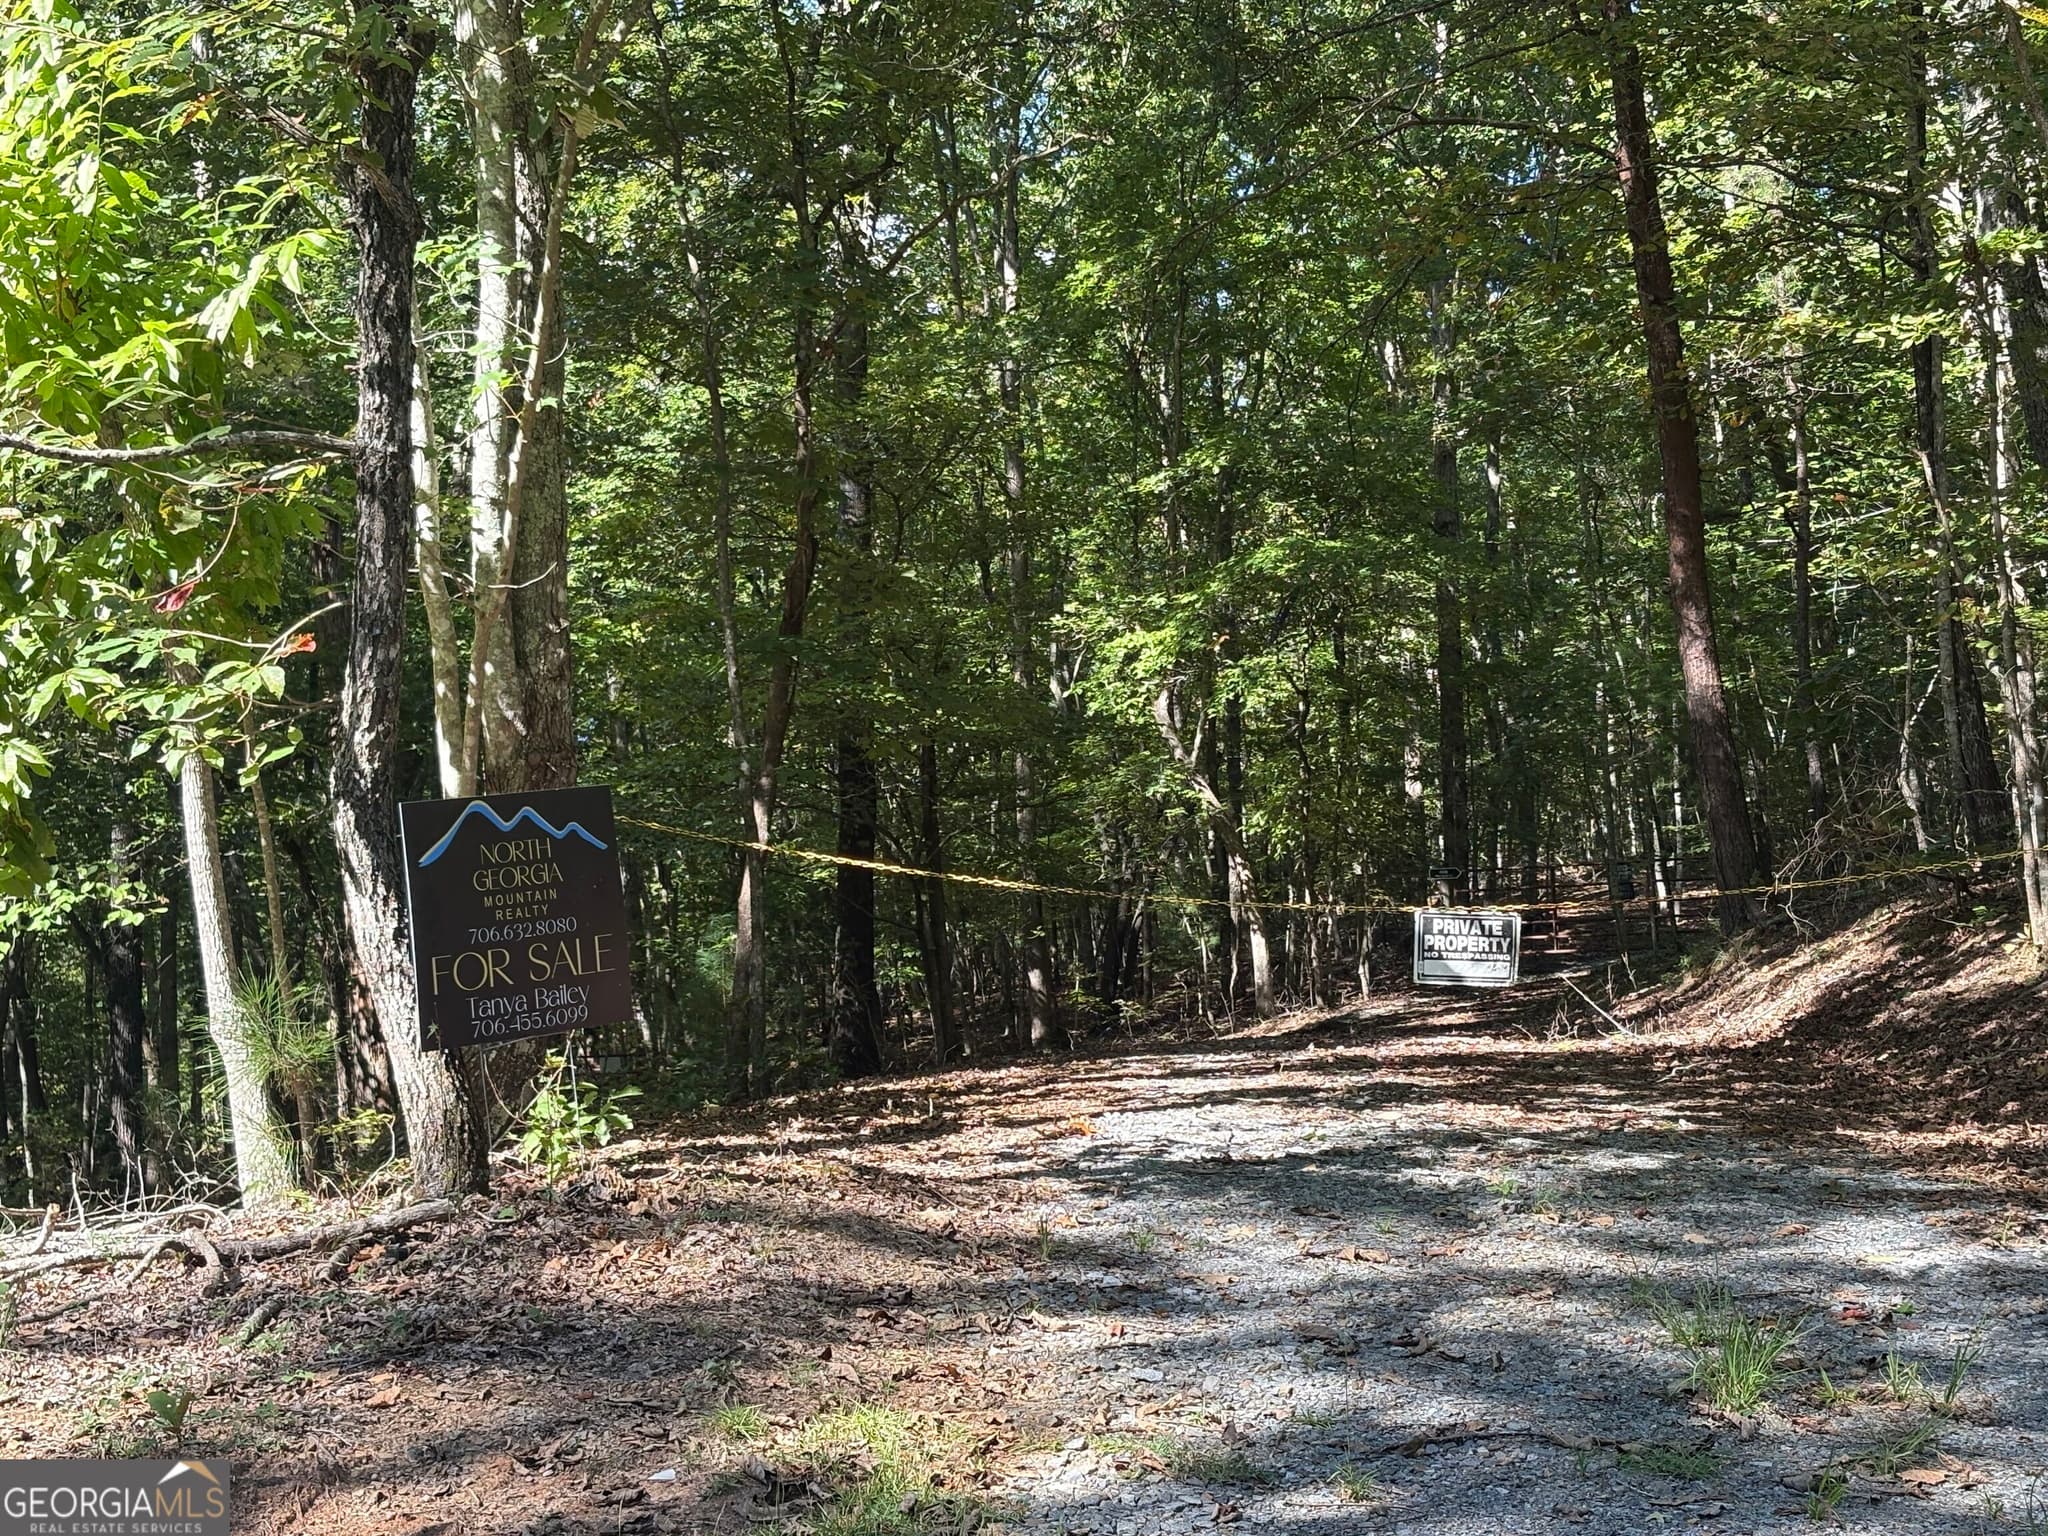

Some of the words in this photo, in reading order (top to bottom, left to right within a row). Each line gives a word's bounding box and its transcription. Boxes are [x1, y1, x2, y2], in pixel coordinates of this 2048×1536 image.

[480, 838, 552, 865] NORTH
[473, 862, 564, 892] GEORGIA
[484, 888, 558, 908] MOUNTAIN
[496, 903, 550, 921] REALTY
[468, 917, 577, 945] 706.632.8080
[1433, 919, 1503, 936] PRIVATE
[1424, 934, 1511, 952] PROPERTY
[1441, 952, 1511, 961] TRESPASSING
[431, 948, 515, 996] FOR
[528, 933, 616, 982] SALE
[465, 994, 528, 1020] Tanya
[534, 984, 590, 1010] Bailey
[471, 1005, 589, 1039] 706.455.6099
